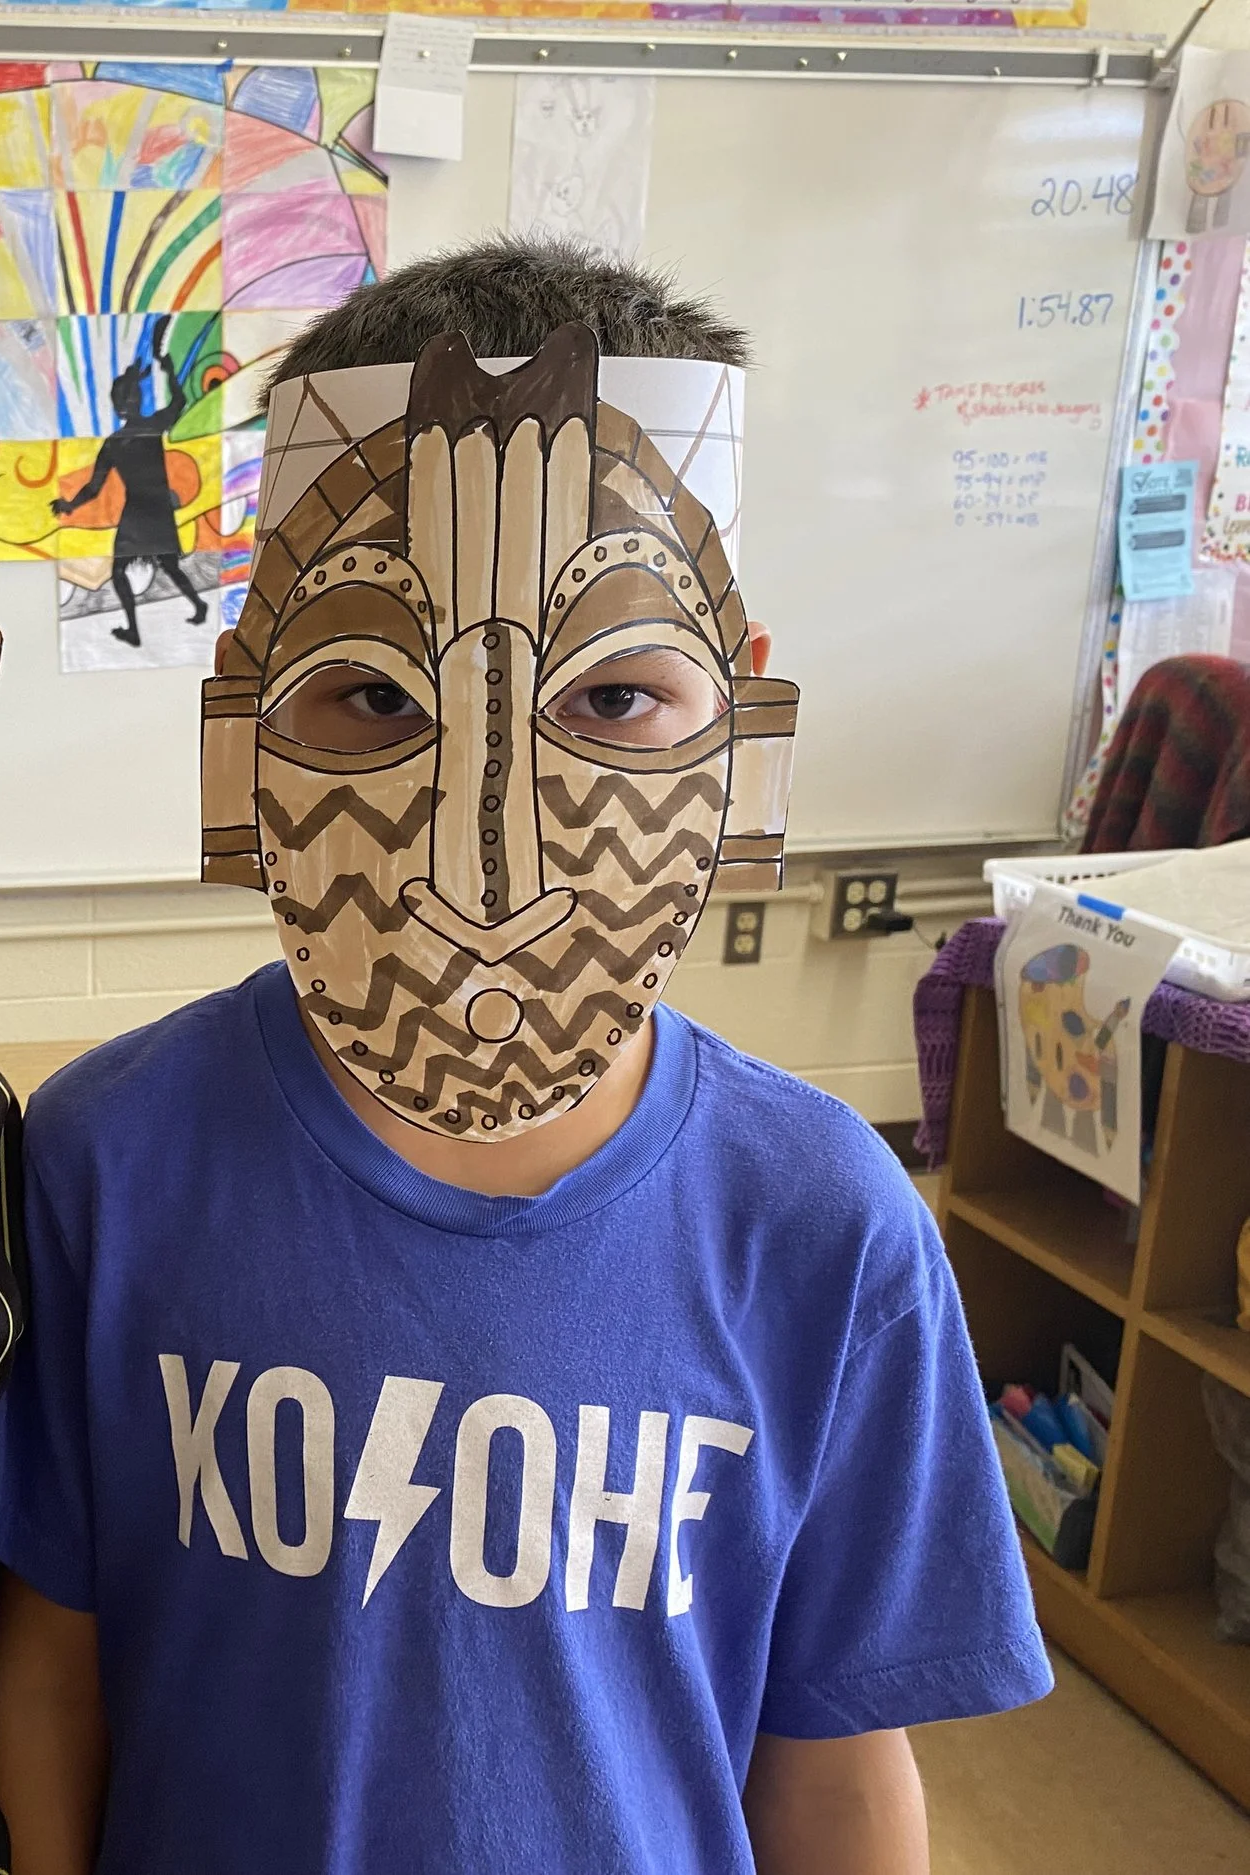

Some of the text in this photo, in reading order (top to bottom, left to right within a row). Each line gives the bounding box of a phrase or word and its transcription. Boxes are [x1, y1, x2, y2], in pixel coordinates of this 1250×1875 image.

[1031, 173, 1139, 218] 20.48
[1057, 905, 1136, 948] Thank You
